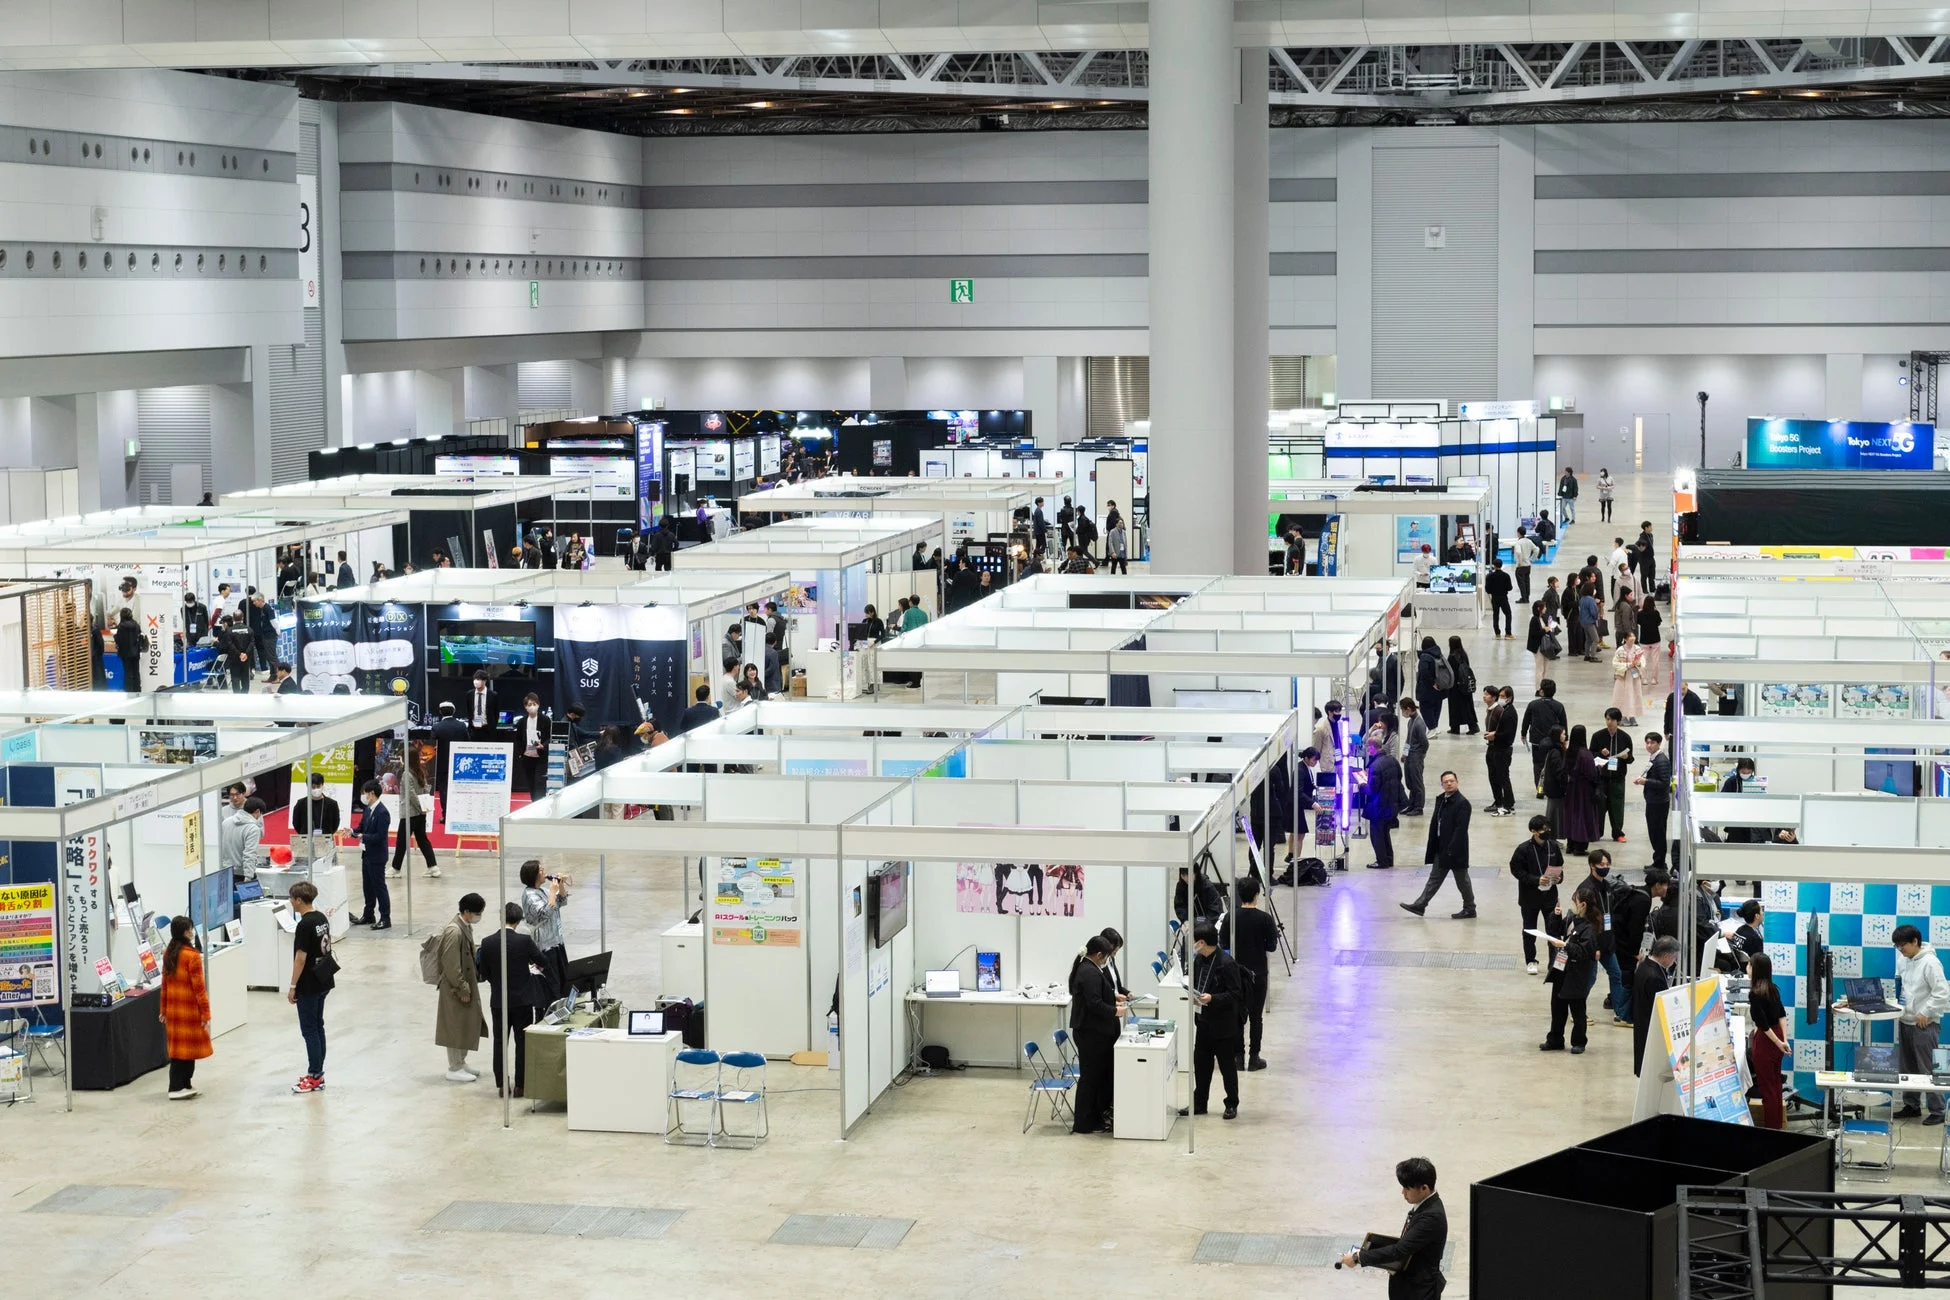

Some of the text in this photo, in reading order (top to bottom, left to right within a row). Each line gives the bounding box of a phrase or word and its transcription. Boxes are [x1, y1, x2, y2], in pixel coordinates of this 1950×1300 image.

[1770, 432, 1799, 443] Tokyo 5G
[1847, 432, 1914, 452] Tokyo NEXT 5G
[1770, 444, 1821, 455] Boosters Project
[149, 614, 161, 676] MeganeX
[580, 679, 600, 688] SUS
